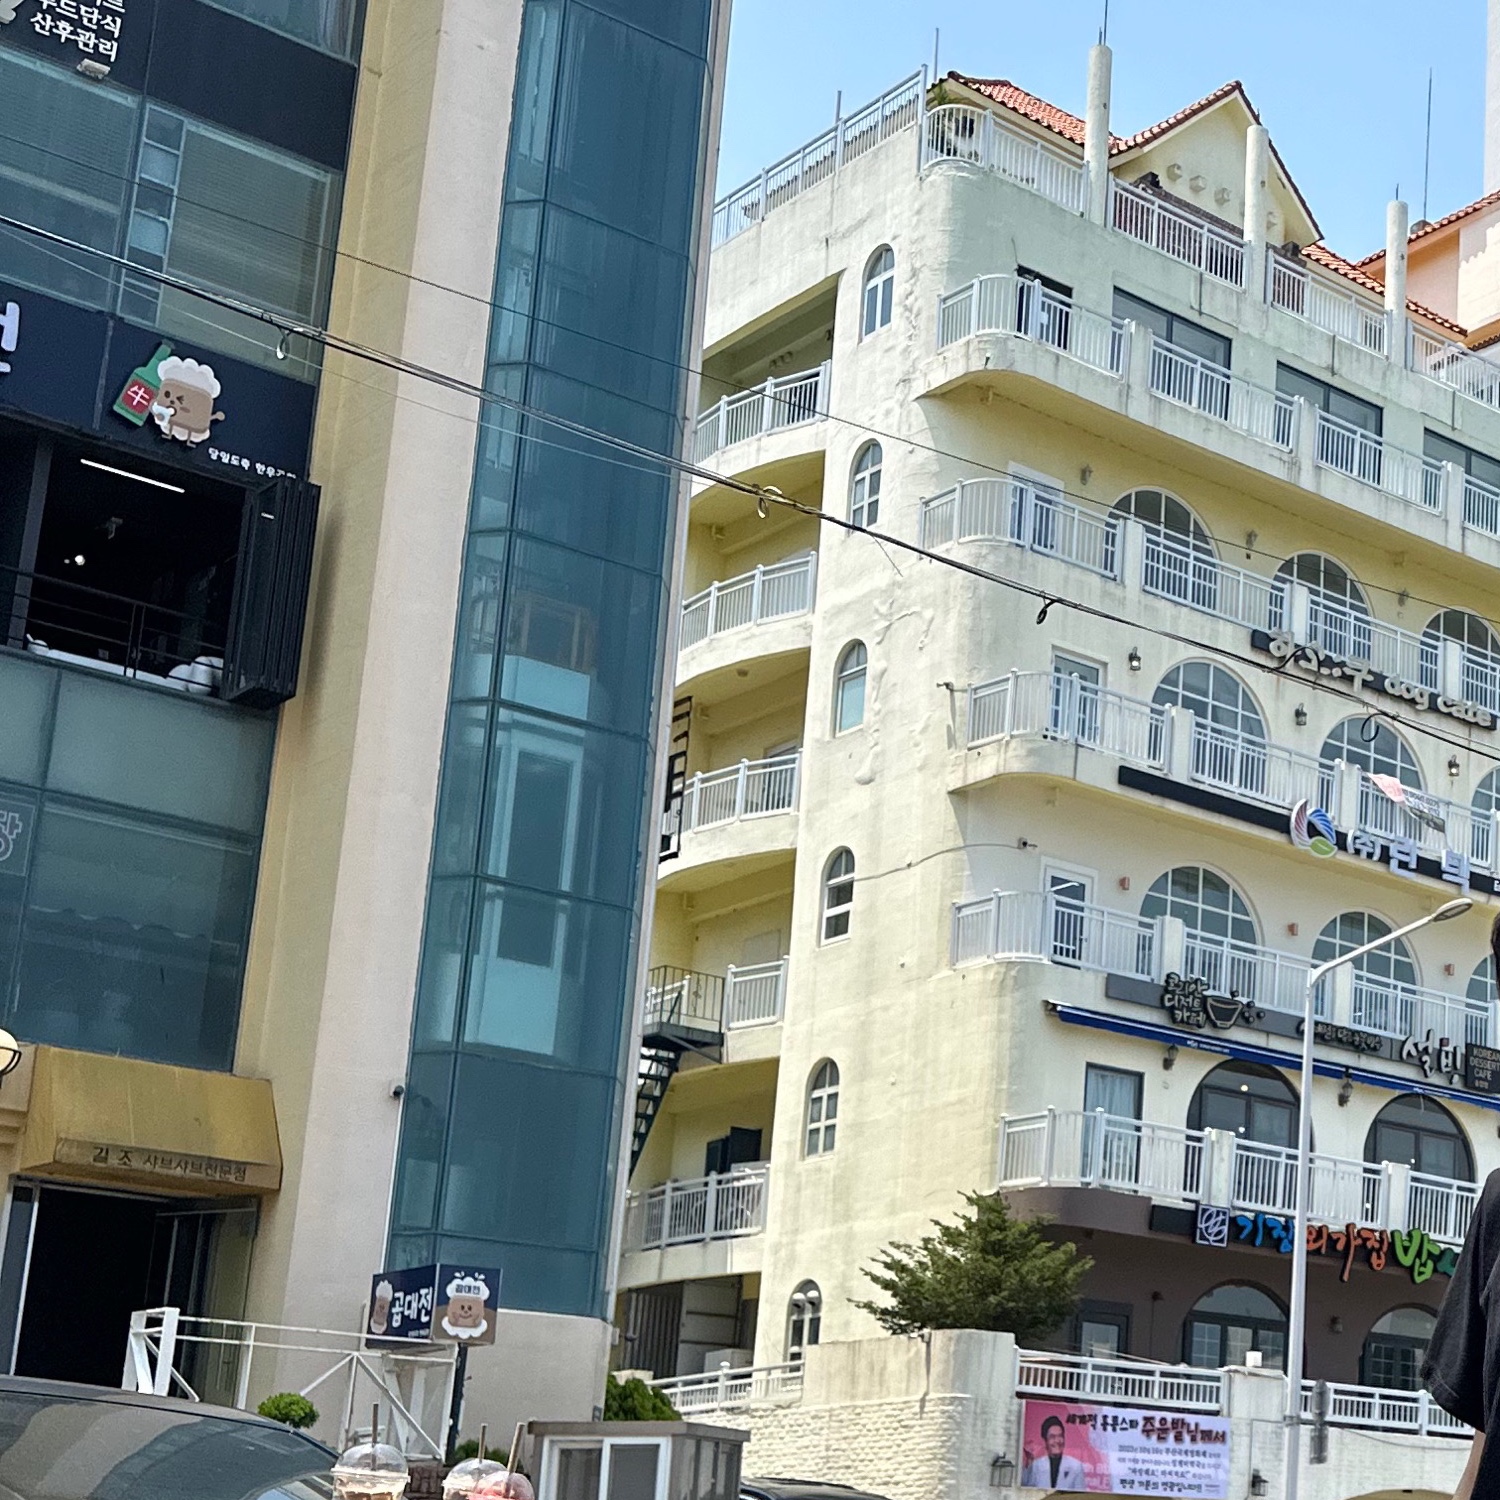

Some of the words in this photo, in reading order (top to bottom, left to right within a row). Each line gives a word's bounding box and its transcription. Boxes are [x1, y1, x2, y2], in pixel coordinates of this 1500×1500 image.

[30, 12, 118, 62] 산후관리
[127, 384, 151, 408] 牛
[1384, 672, 1430, 710] dog
[1437, 695, 1491, 727] cafe
[1167, 973, 1209, 998] 코리안
[1164, 994, 1202, 1011] 디저트
[1174, 1007, 1207, 1026] 카페
[1402, 1029, 1462, 1084] 설빙
[1469, 1056, 1500, 1072] DESSERT
[1473, 1067, 1493, 1081] CAFE
[143, 1154, 247, 1182] 샤브샤브전문점
[391, 1286, 433, 1328] 곱대전
[1141, 1416, 1227, 1445] 주윤발님께서
